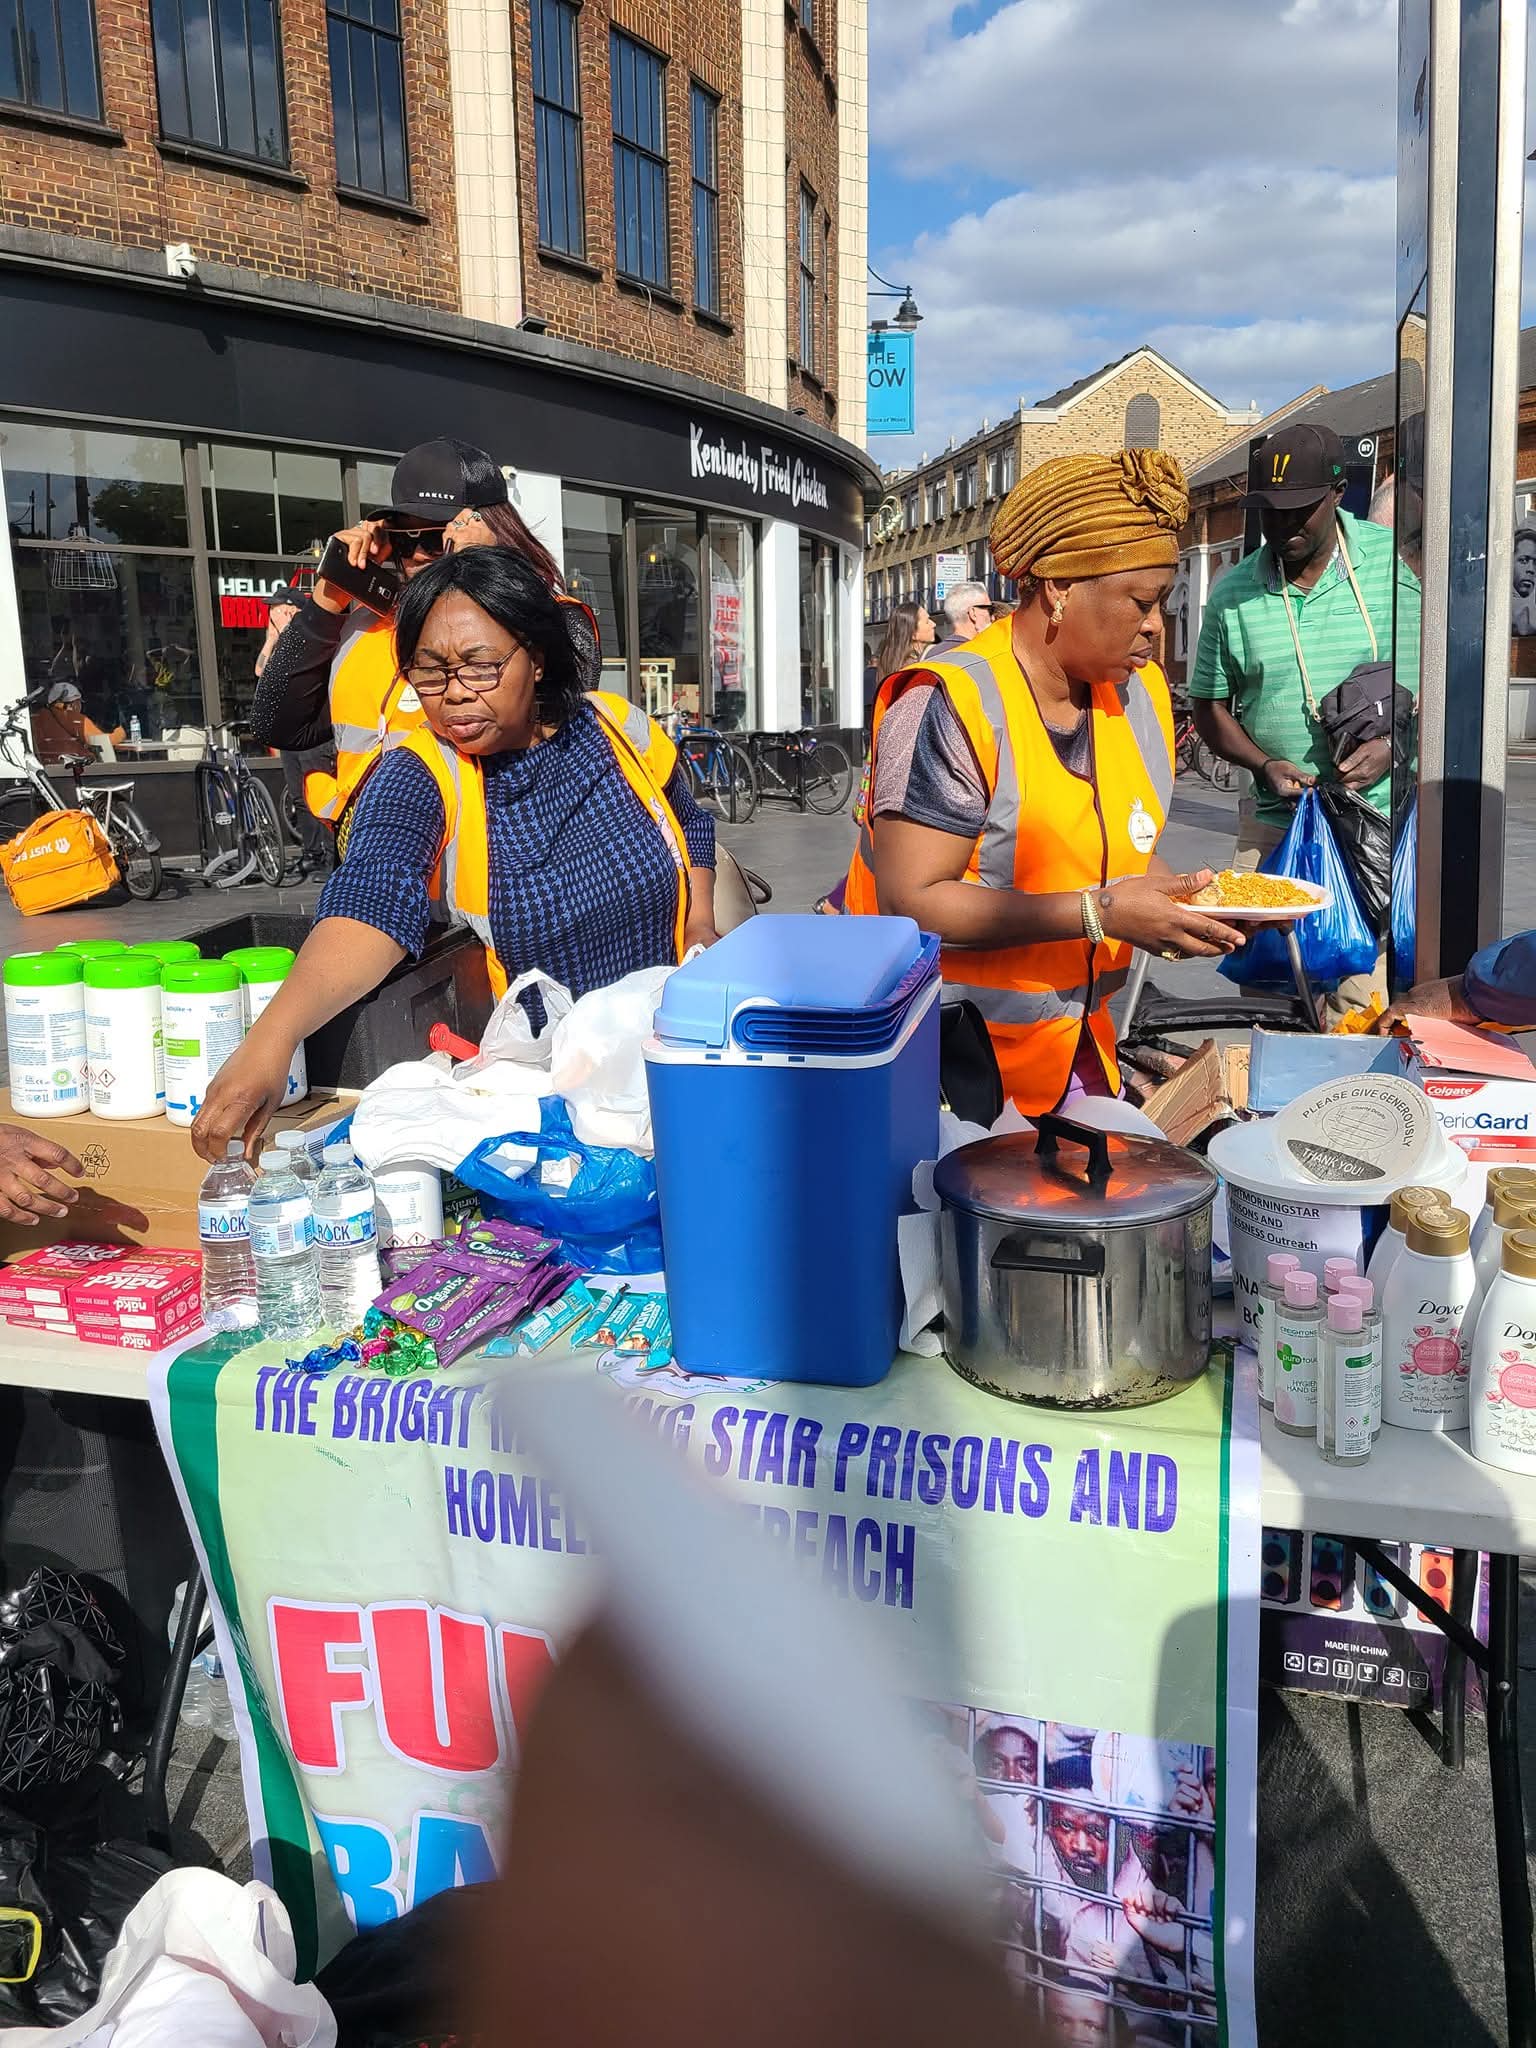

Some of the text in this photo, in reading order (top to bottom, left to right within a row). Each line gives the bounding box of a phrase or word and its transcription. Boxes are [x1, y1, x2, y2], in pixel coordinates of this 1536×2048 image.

[868, 368, 906, 388] OW
[690, 422, 759, 494] Kentucky
[761, 447, 791, 495] Fried
[1426, 1086, 1474, 1096] Colgate
[1302, 1088, 1416, 1148] PLEASE GIVE GENEROUSLY
[1302, 1148, 1365, 1177] THANK YOU!
[210, 1214, 247, 1234] ROCK
[1260, 1215, 1283, 1229] AND
[317, 1223, 351, 1242] ROCK
[1266, 1232, 1318, 1251] Outreach
[413, 1275, 468, 1313] Organix
[1418, 1300, 1463, 1315] Dove
[1282, 1354, 1301, 1363] pure
[1286, 1385, 1309, 1393] HAND
[1292, 1379, 1317, 1387] HYGIEN
[254, 1366, 317, 1436] THE
[332, 1373, 486, 1449] BRIGHT
[704, 1406, 823, 1489] STAR
[833, 1422, 1053, 1519] PRISONS
[1069, 1448, 1178, 1533] AND
[1325, 1640, 1388, 1657] MADE IN CHINA
